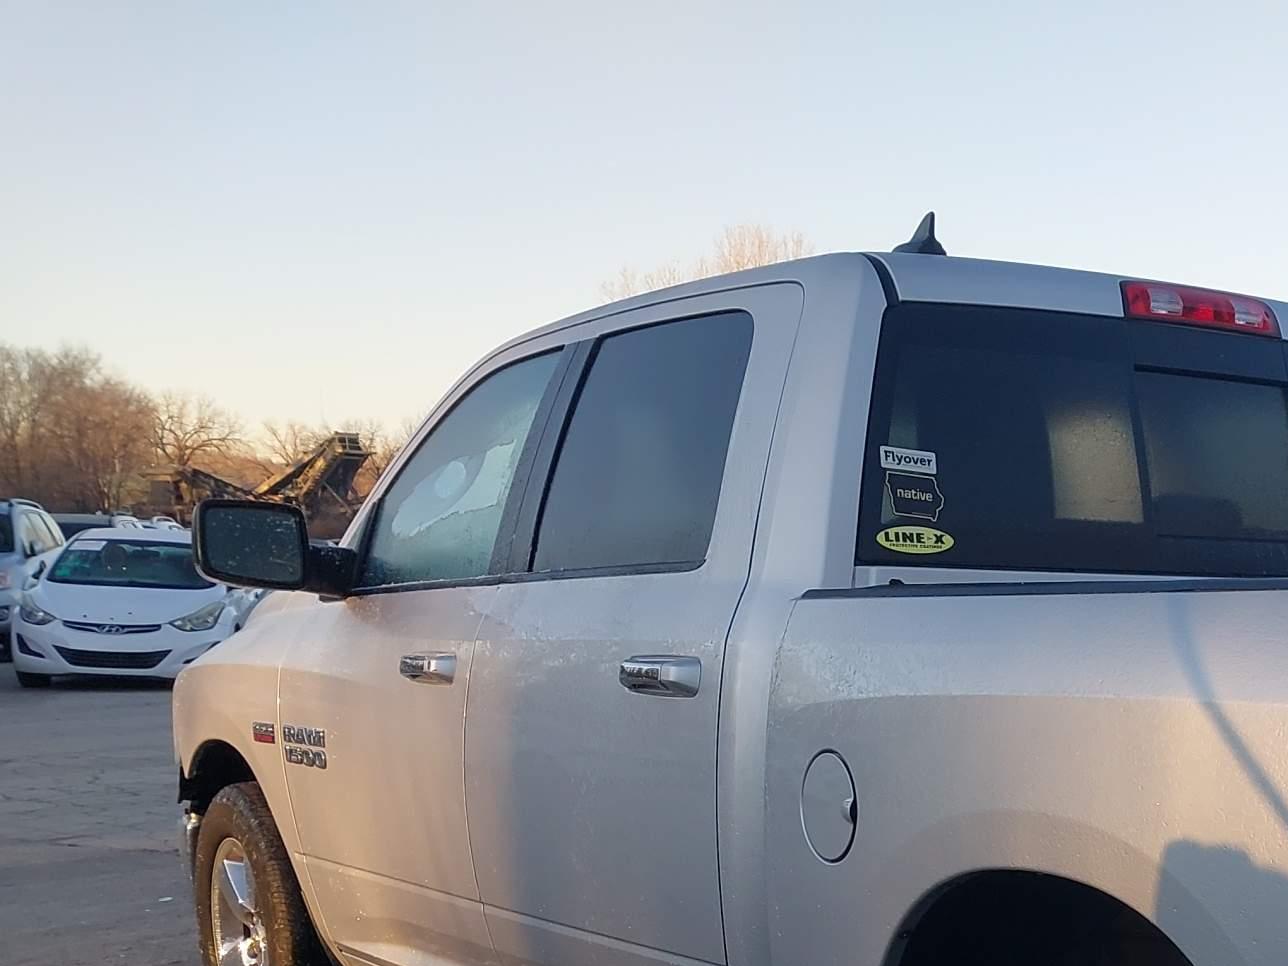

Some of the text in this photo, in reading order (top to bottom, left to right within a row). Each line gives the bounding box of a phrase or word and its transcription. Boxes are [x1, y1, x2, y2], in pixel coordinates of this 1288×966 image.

[883, 449, 933, 467] Flyover
[896, 488, 934, 502] native
[883, 531, 946, 545] LINE-X
[283, 725, 326, 748] RAM
[285, 745, 327, 769] 1500
